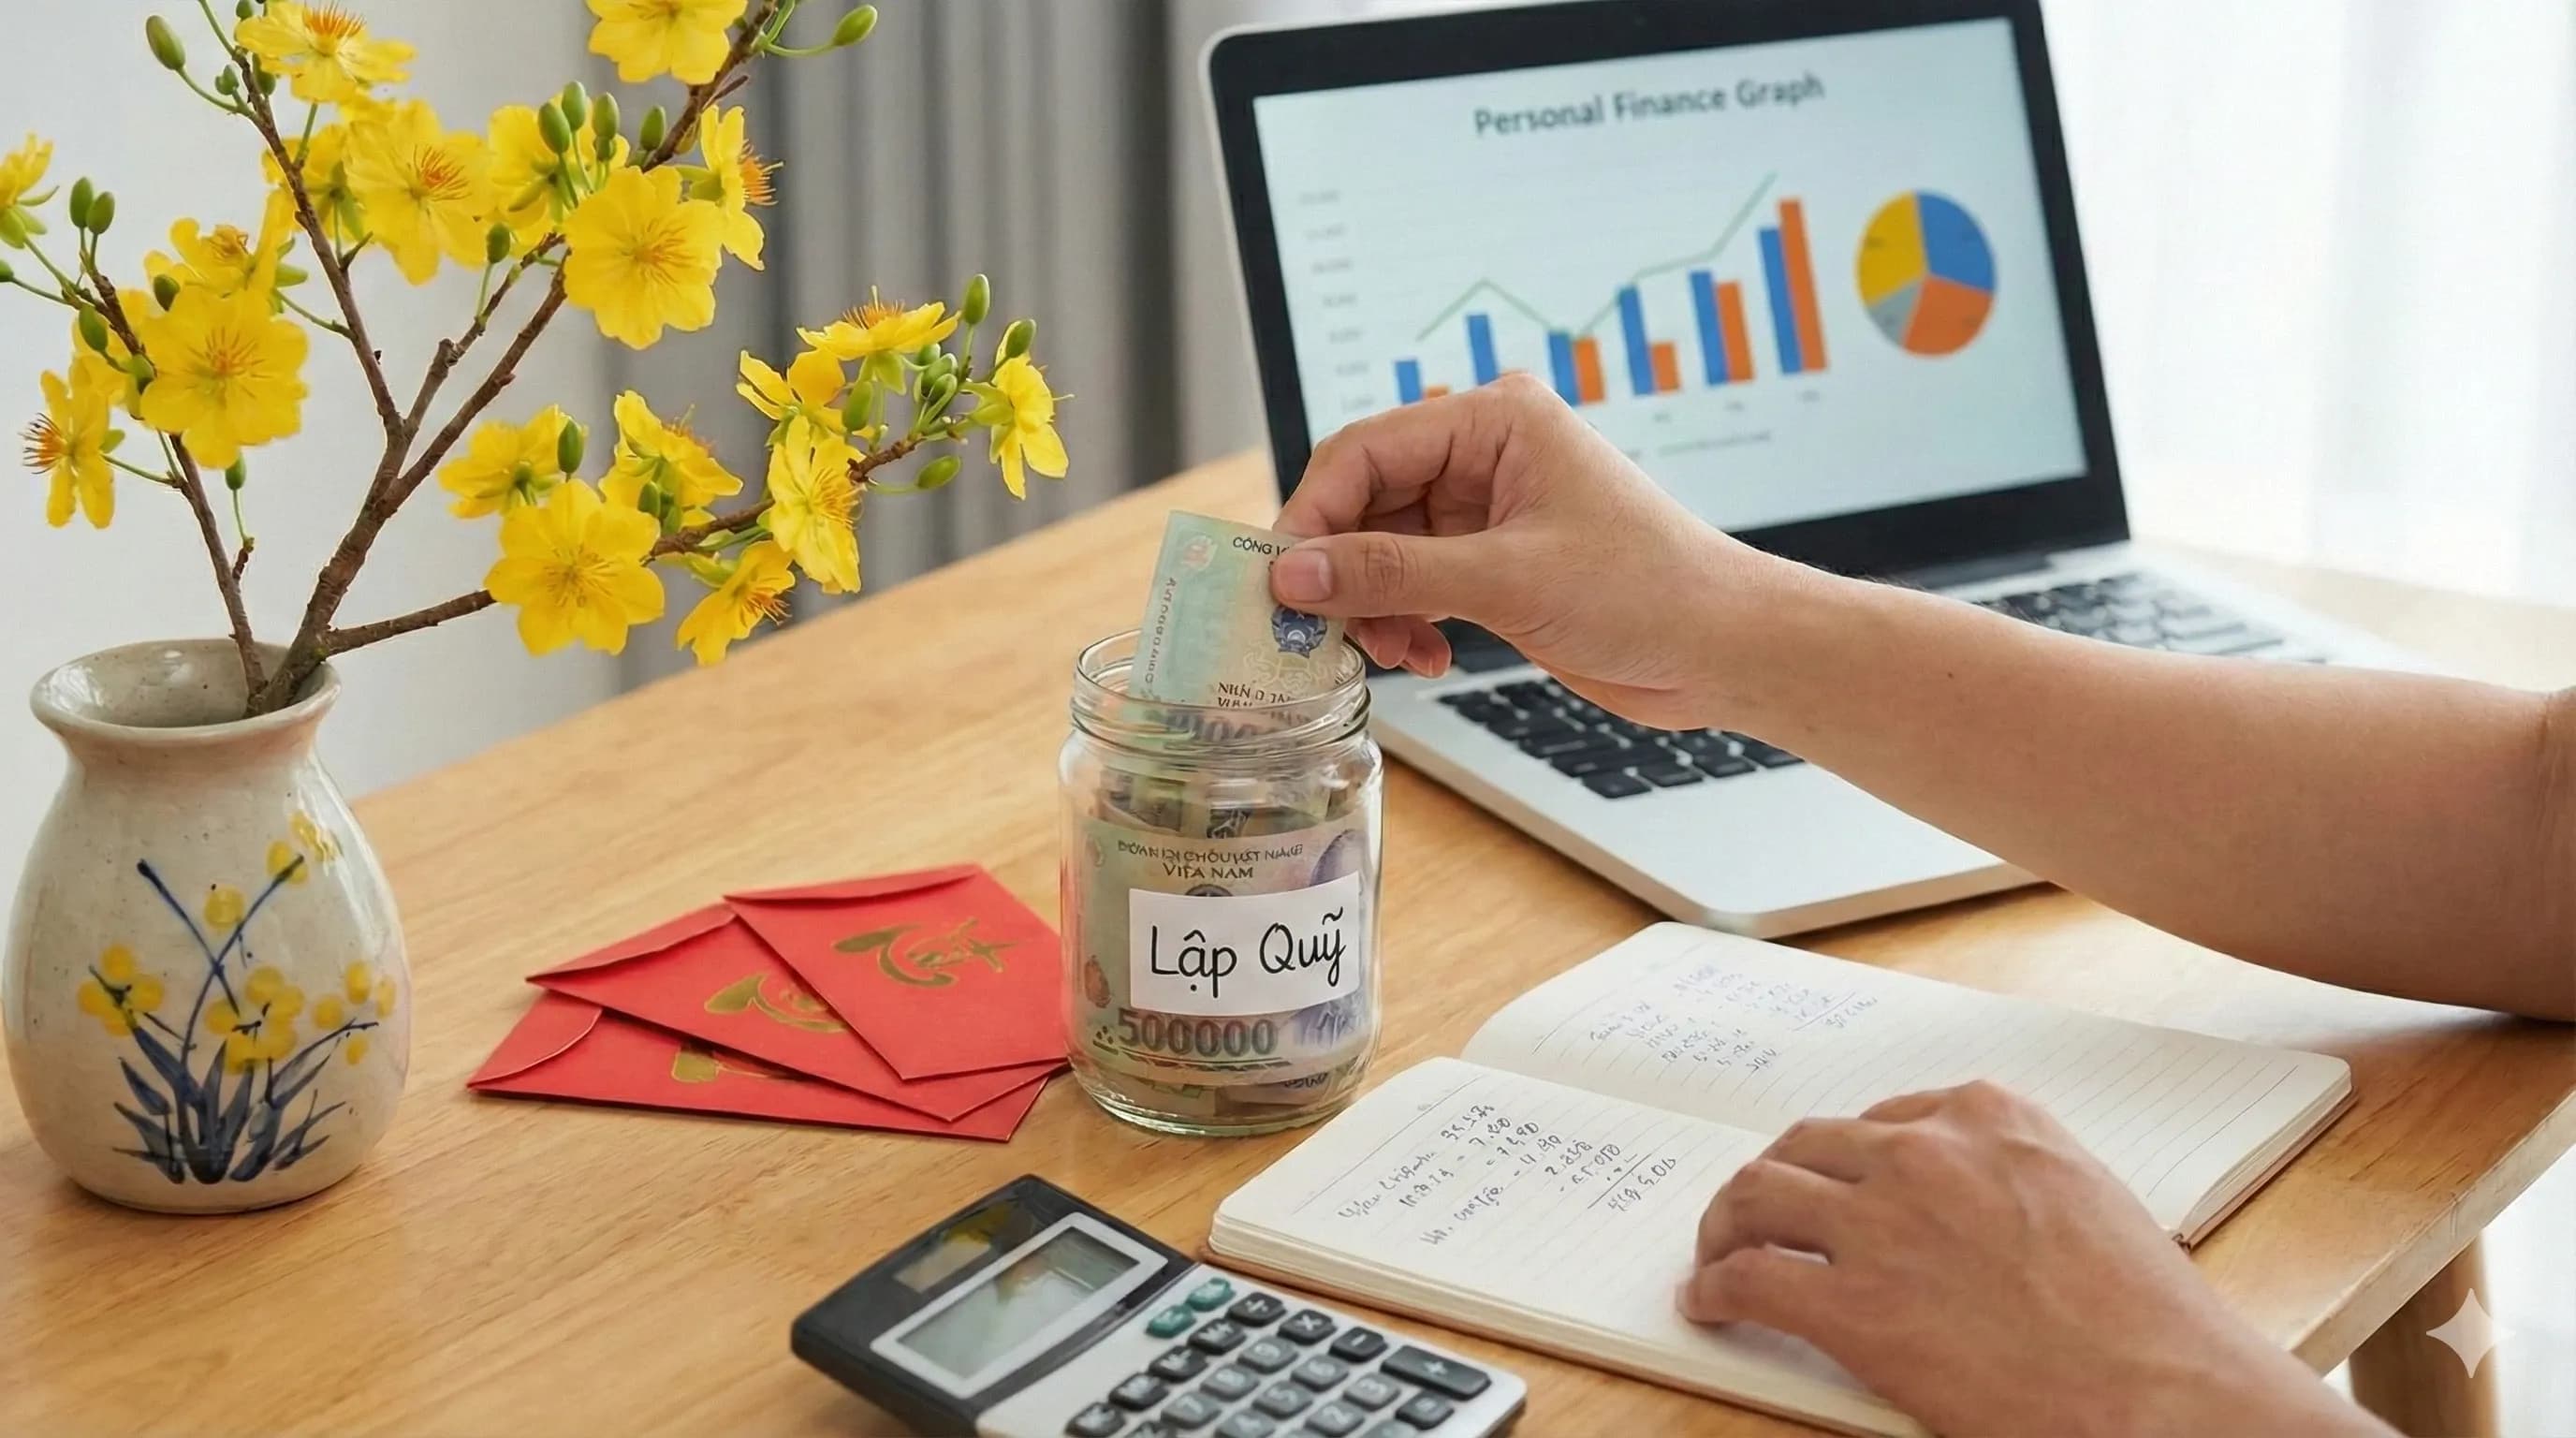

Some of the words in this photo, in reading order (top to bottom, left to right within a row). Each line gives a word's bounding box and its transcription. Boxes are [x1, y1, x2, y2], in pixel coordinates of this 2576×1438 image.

[1473, 95, 1604, 135] Personal
[1613, 89, 1726, 120] Finance
[1735, 70, 1825, 108] Graph
[1150, 924, 1238, 999] Lập
[1259, 906, 1347, 988] Quỹ
[1118, 1007, 1280, 1057] 500000
